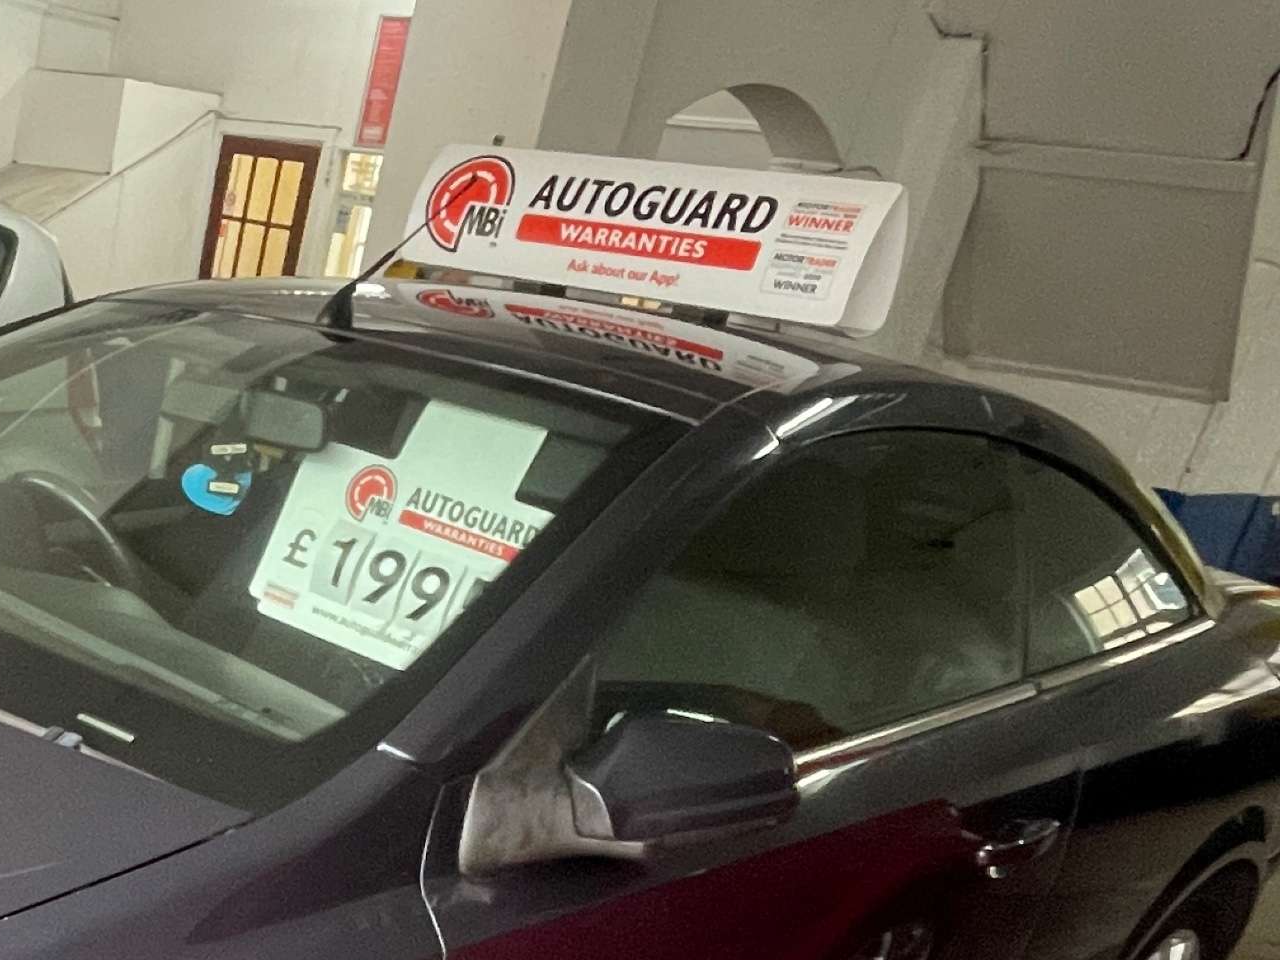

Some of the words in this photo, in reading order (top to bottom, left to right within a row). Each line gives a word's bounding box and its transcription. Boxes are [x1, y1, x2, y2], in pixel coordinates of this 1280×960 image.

[528, 174, 779, 234] AUTOGUARD
[559, 222, 709, 259] WARRANTIES
[788, 214, 854, 232] WINNER
[567, 259, 588, 273] Ask
[591, 262, 625, 277] about
[628, 269, 648, 281] our
[773, 279, 818, 294] WINNER
[405, 487, 542, 546] AUTOGUARD
[423, 519, 503, 557] WARRANTIES
